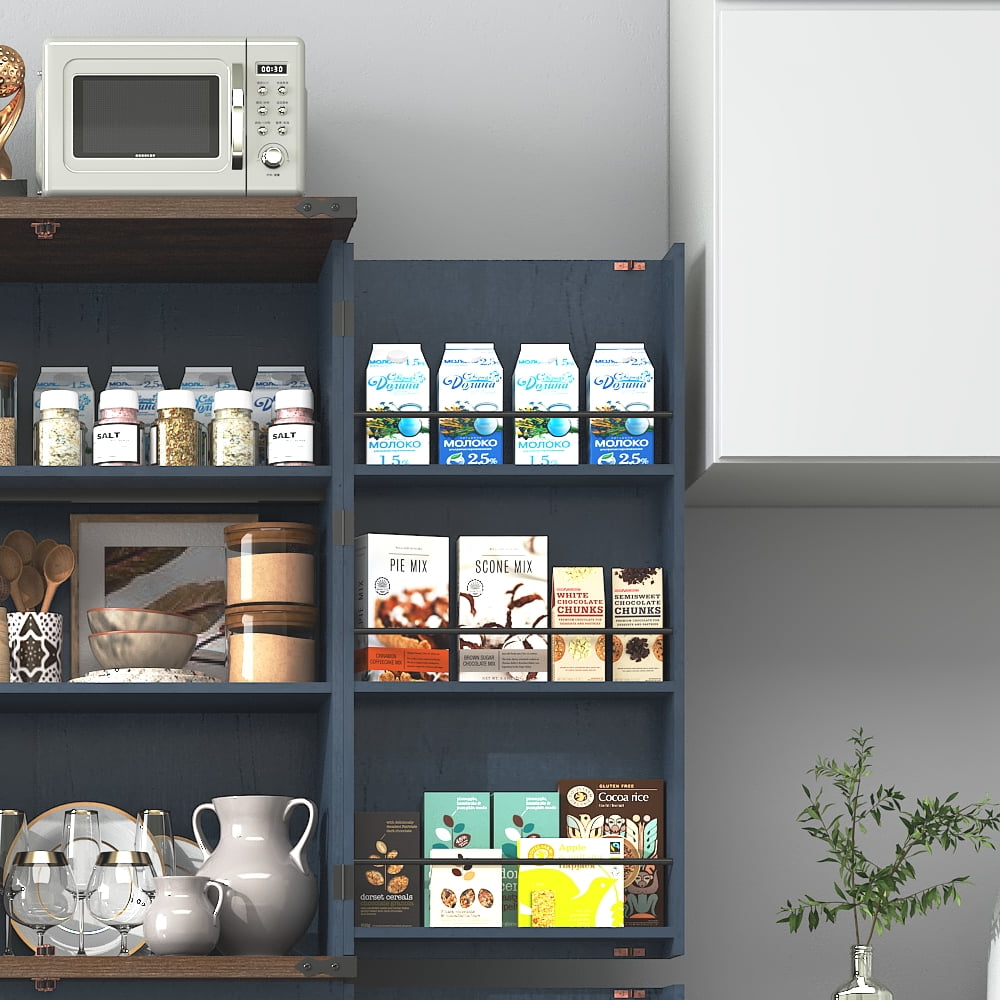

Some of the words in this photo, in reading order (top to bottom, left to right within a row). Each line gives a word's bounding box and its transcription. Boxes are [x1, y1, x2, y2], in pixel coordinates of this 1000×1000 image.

[261, 65, 283, 73] 00:30
[97, 431, 121, 439] SALT
[273, 431, 297, 439] SALT
[368, 441, 422, 449] МОЛОКО
[443, 439, 498, 447] МОЛОКО
[518, 441, 571, 449] МОЛОКО
[594, 439, 649, 447] МОЛОКО
[390, 558, 406, 573] PIE
[410, 560, 428, 573] MIX
[475, 560, 510, 574] SCONE
[514, 560, 533, 574] MIX
[557, 606, 604, 614] CHUNKS
[614, 607, 661, 615] CHUNKS
[598, 791, 629, 802] Cocoa
[631, 792, 650, 802] rice
[559, 844, 587, 852] Apple
[360, 893, 385, 901] dorset
[386, 893, 414, 901] cereals
